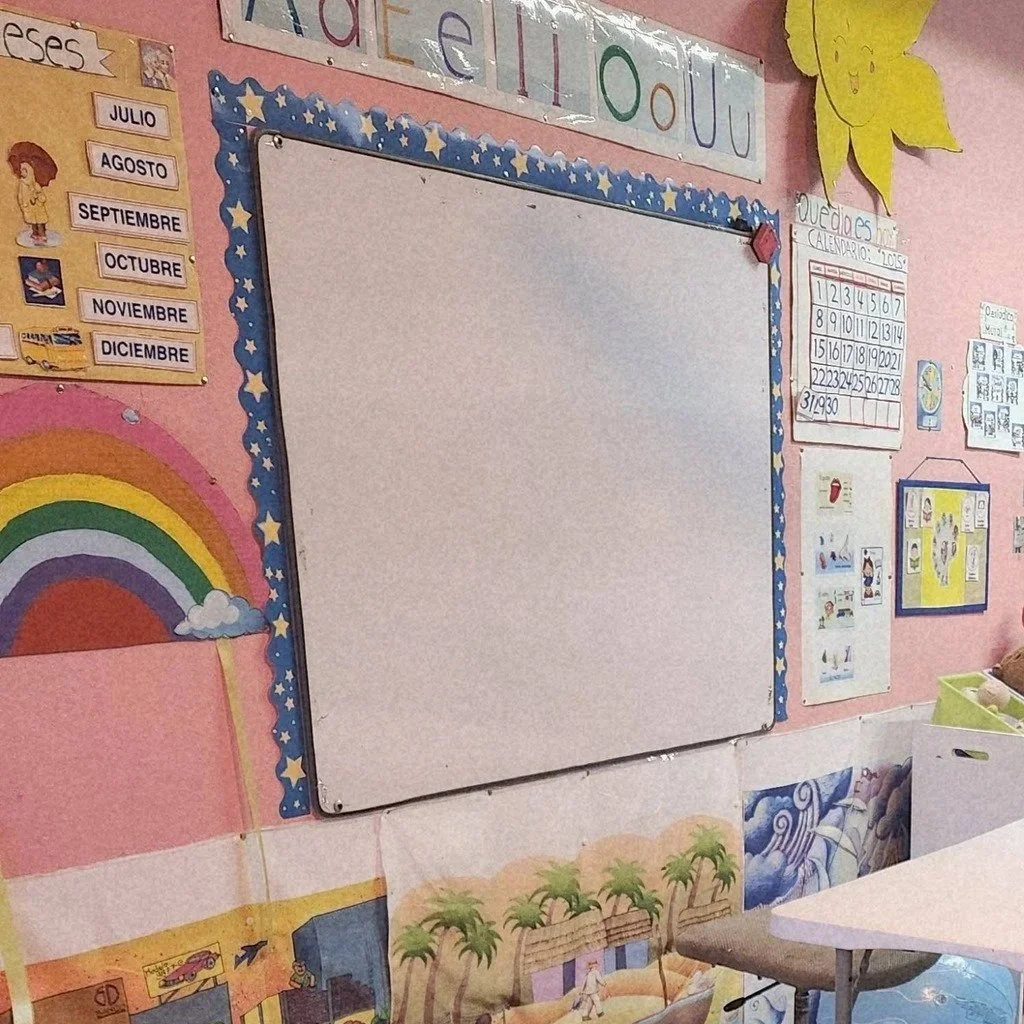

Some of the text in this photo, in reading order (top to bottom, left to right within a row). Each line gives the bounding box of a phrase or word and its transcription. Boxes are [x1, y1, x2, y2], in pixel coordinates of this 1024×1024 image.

[108, 104, 157, 128] JULIO
[100, 151, 169, 180] AGOSTO
[77, 202, 182, 233] SEPTIEMBRE
[103, 252, 183, 279] OCTUBRE
[92, 297, 188, 324] NOVIEMBRE
[100, 339, 190, 364] DICIEMBRE
